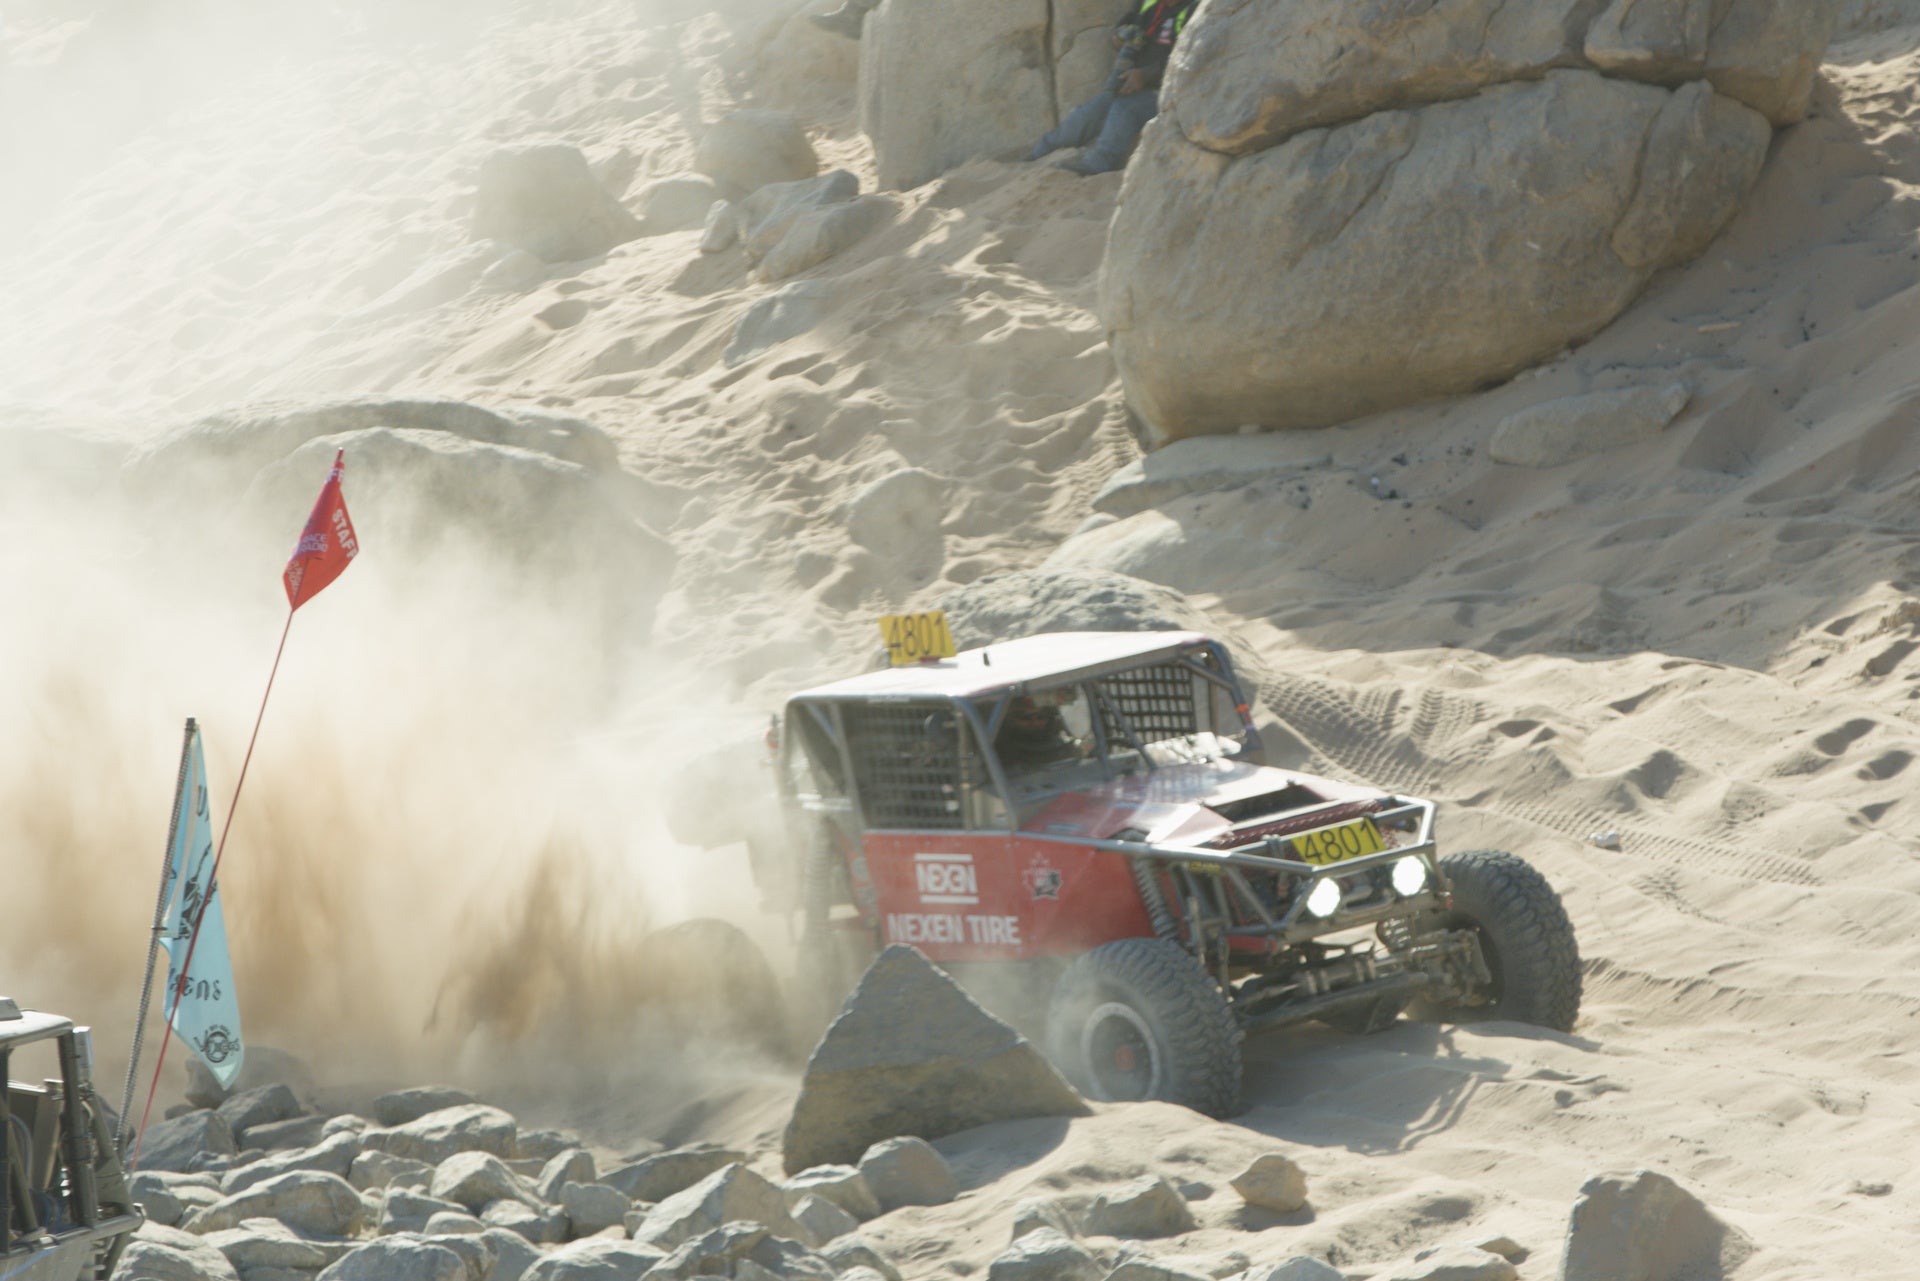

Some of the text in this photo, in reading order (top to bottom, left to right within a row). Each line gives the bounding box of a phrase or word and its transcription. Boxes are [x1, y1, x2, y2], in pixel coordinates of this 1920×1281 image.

[888, 613, 946, 657] 4801
[1303, 819, 1379, 864] 4801
[887, 913, 1021, 944] NEXEN TIRE
